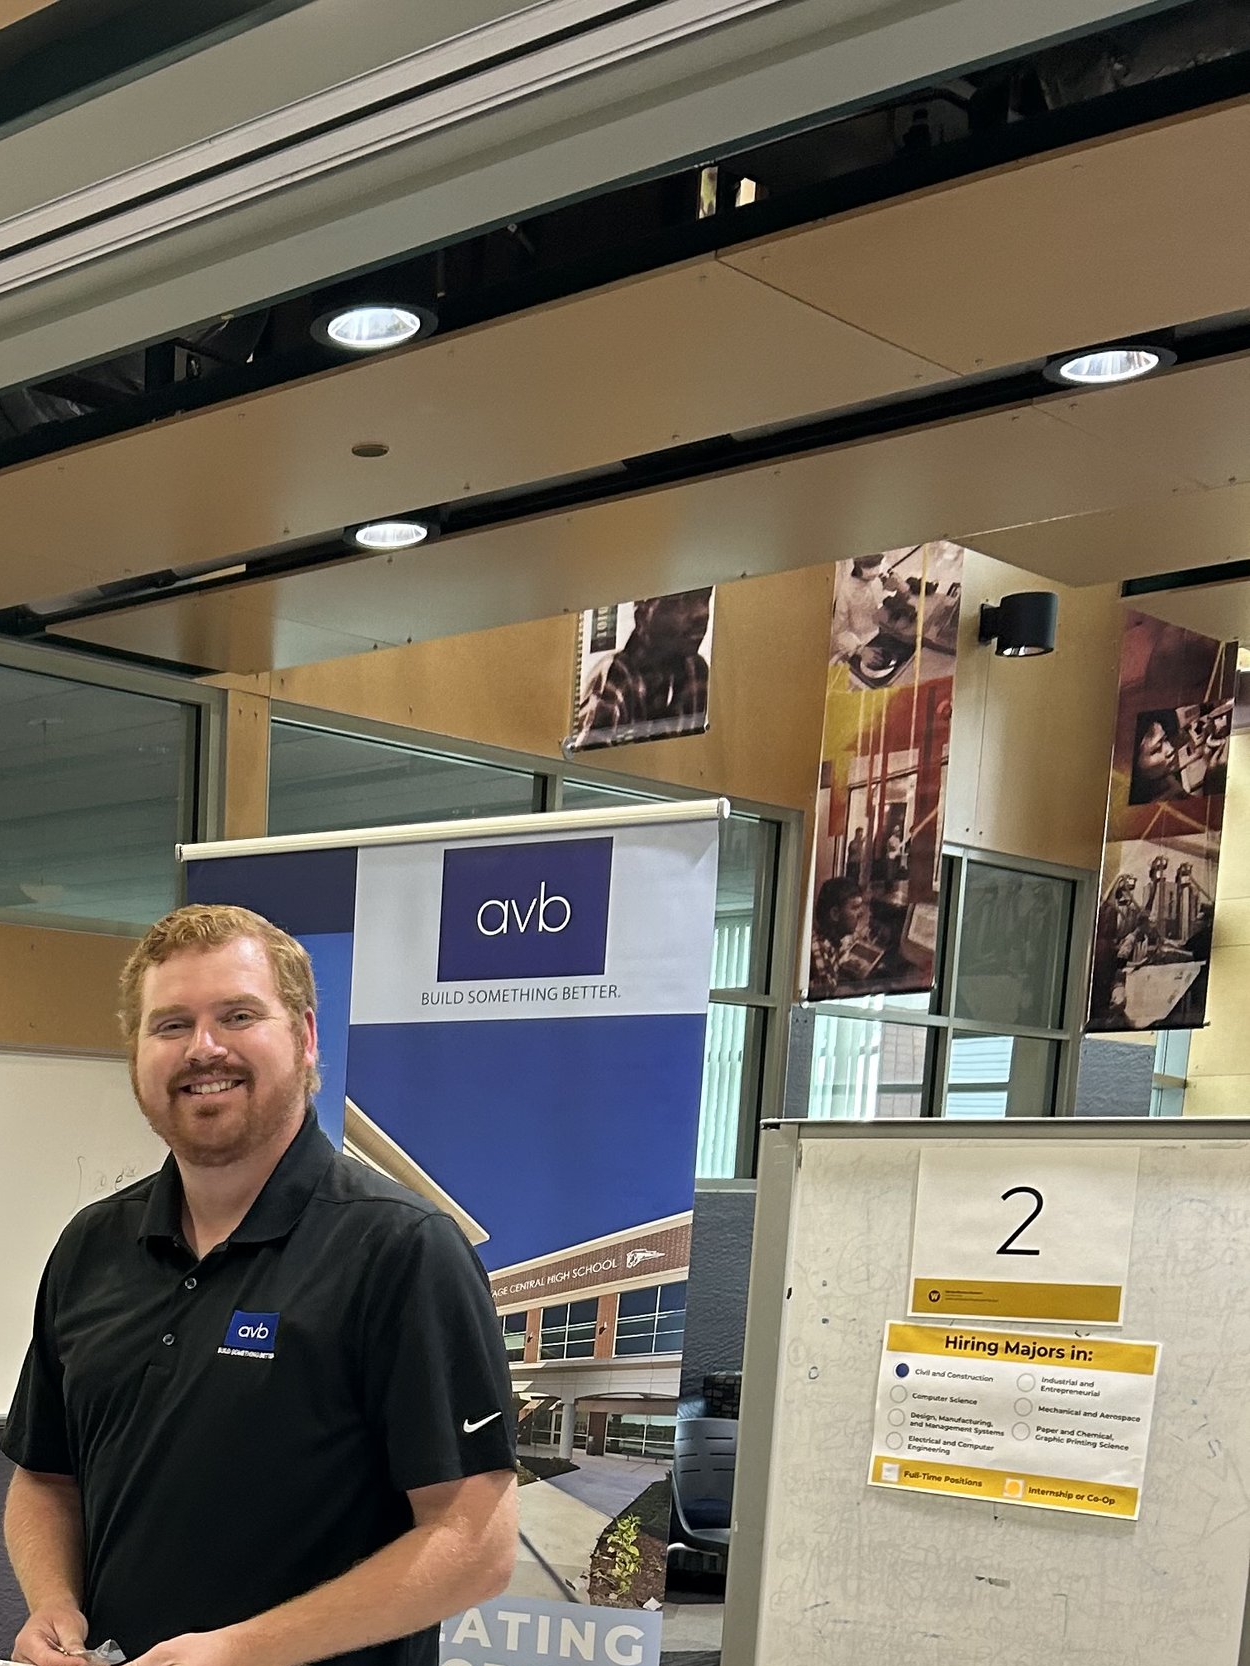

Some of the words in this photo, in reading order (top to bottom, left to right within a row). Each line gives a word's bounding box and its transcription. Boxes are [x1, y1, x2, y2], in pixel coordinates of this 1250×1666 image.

[476, 881, 572, 936] avb
[421, 990, 464, 1006] BUILD
[468, 986, 558, 1004] SOMETHING
[562, 984, 621, 1000] BETTER.
[995, 1186, 1044, 1256] 2
[509, 1277, 546, 1293] CENTRAL
[546, 1270, 570, 1284] HIGH
[572, 1258, 618, 1279] SCHOOL
[238, 1322, 269, 1339] avb
[945, 1335, 999, 1356] Hiring
[1004, 1340, 1065, 1361] Majors
[1070, 1344, 1094, 1362] in:
[914, 1368, 931, 1376] Civil
[931, 1370, 946, 1378] and
[947, 1371, 994, 1382] Construction
[1041, 1376, 1078, 1386] Industrial
[1079, 1380, 1095, 1388] and
[911, 1392, 948, 1402] Computer
[949, 1396, 978, 1405] Science
[1040, 1385, 1101, 1397] Entrepreneurial
[1038, 1405, 1081, 1416] Mechanical
[1082, 1410, 1098, 1418] and
[1099, 1411, 1141, 1423] Aerospace
[909, 1420, 924, 1428] and
[925, 1422, 973, 1433] Management
[973, 1427, 1005, 1437] Systems
[1036, 1425, 1059, 1436] Paper
[1060, 1428, 1075, 1436] and
[907, 1443, 951, 1456] Engineering
[908, 1435, 941, 1445] Electrical
[957, 1441, 994, 1451] Computer
[1035, 1434, 1064, 1445] Graphic
[1066, 1437, 1098, 1449] Printing
[1099, 1441, 1129, 1451] Science
[903, 1470, 943, 1482] Full-Time
[944, 1475, 983, 1487] Positions
[1028, 1486, 1074, 1500] Internship
[1075, 1493, 1085, 1501] or
[1086, 1494, 1116, 1506] Co-Op
